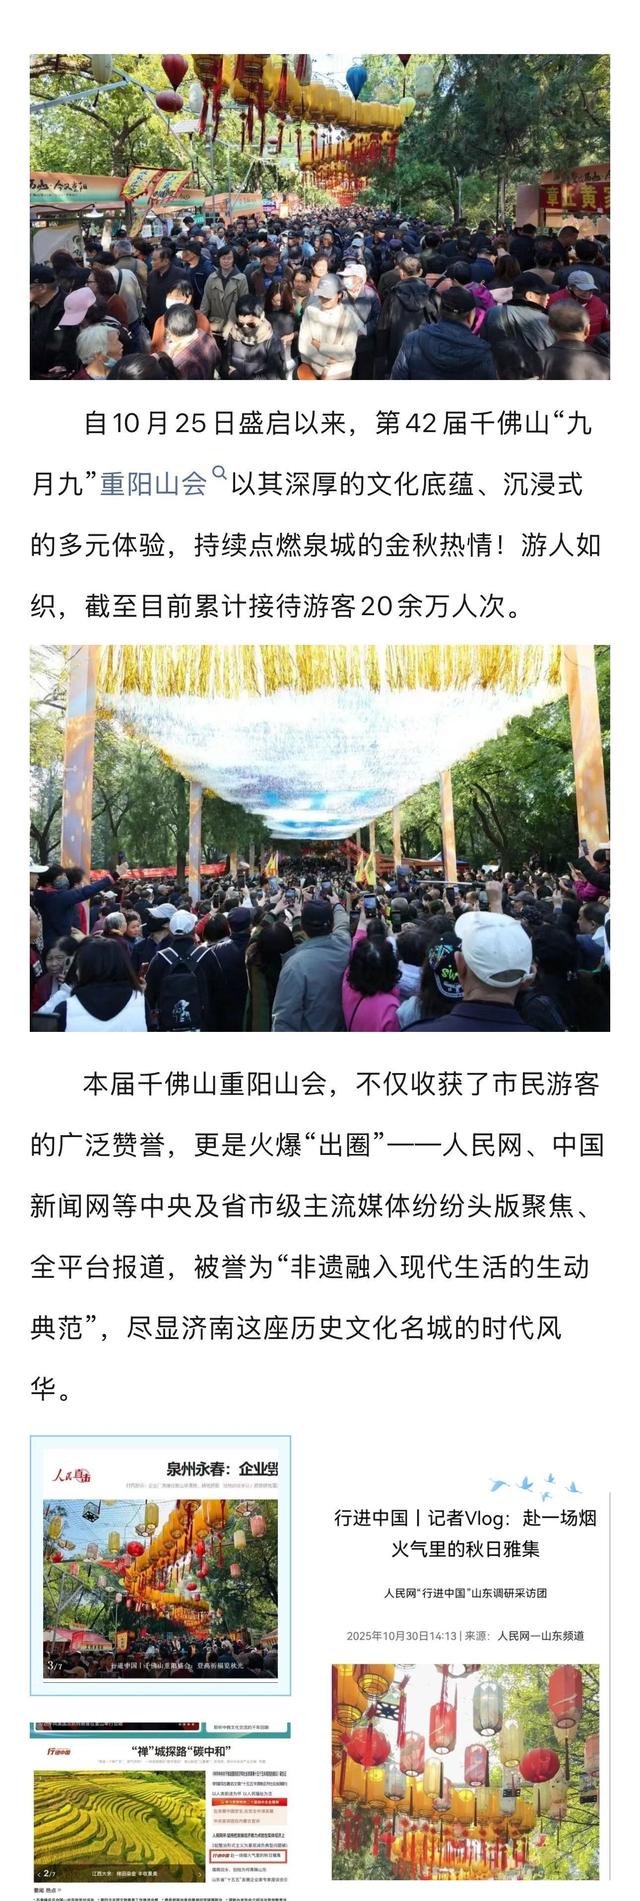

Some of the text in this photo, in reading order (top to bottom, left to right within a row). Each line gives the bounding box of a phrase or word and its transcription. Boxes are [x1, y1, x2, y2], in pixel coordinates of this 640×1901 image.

[32, 532, 599, 558] 的多元体验，持续点燃泉城的金秋热情！游人如
[31, 593, 526, 620] 织，截至目前累计接待游客20余万人次。
[83, 1071, 599, 1097] 本届千佛山重阳山会，不仅收获了市民游客
[31, 1193, 592, 1218] 新闻网等中央及省市级主流媒体纷纷头版聚焦、
[31, 1254, 588, 1280] 全平台报道，被誉为“非遗融入现代生活的生动
[31, 1315, 561, 1341] 典范”，尽显济南这座历史文化名城的时代风
[31, 1376, 72, 1401] 华。
[392, 1540, 540, 1558] 火气里的秋日雅集
